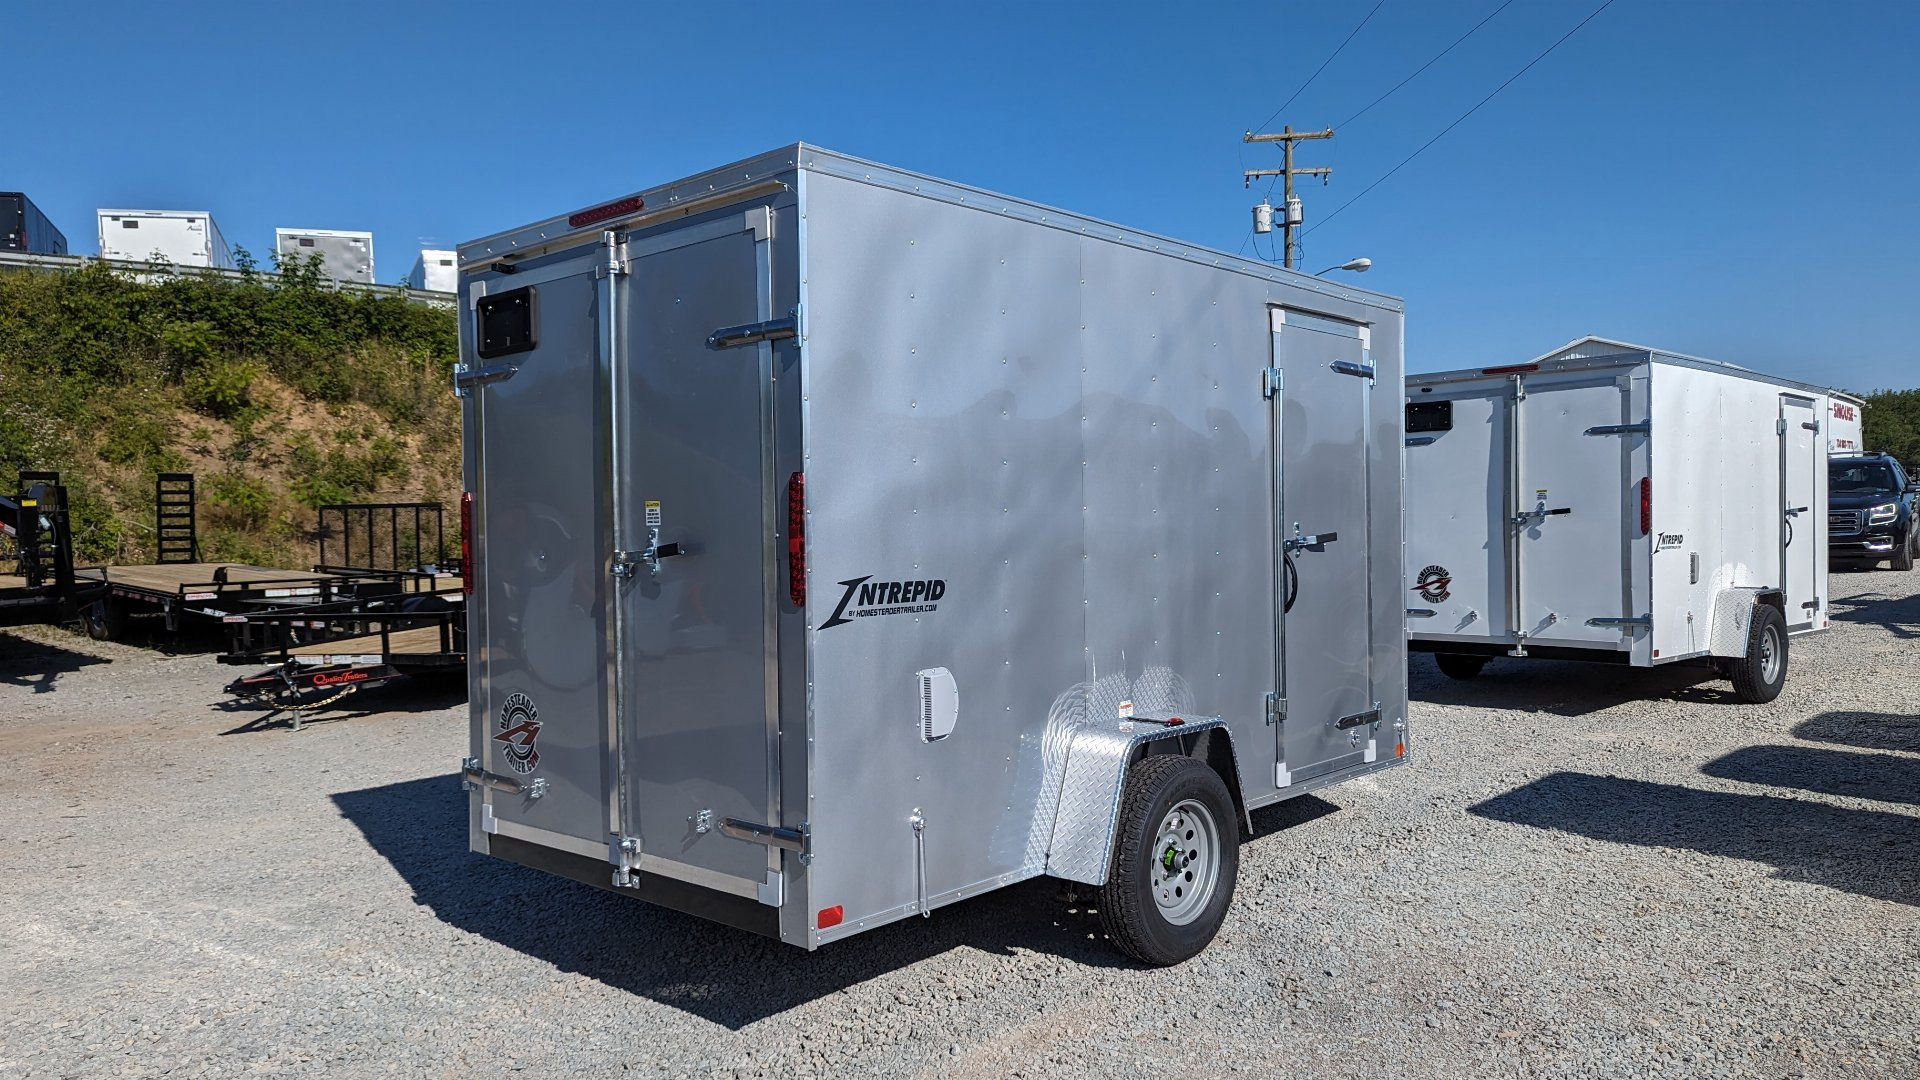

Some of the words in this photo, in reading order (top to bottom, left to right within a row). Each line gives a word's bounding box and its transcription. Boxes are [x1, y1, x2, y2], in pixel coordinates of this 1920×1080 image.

[1653, 532, 1684, 554] INTREPID
[816, 575, 946, 631] INTREPID
[856, 604, 937, 617] HOMESTEADERTRAILER.COM
[313, 673, 343, 685] Quality
[342, 670, 368, 681] Trailers
[500, 693, 538, 730] HOMESTEADER
[502, 744, 540, 774] TRAILER.COM
